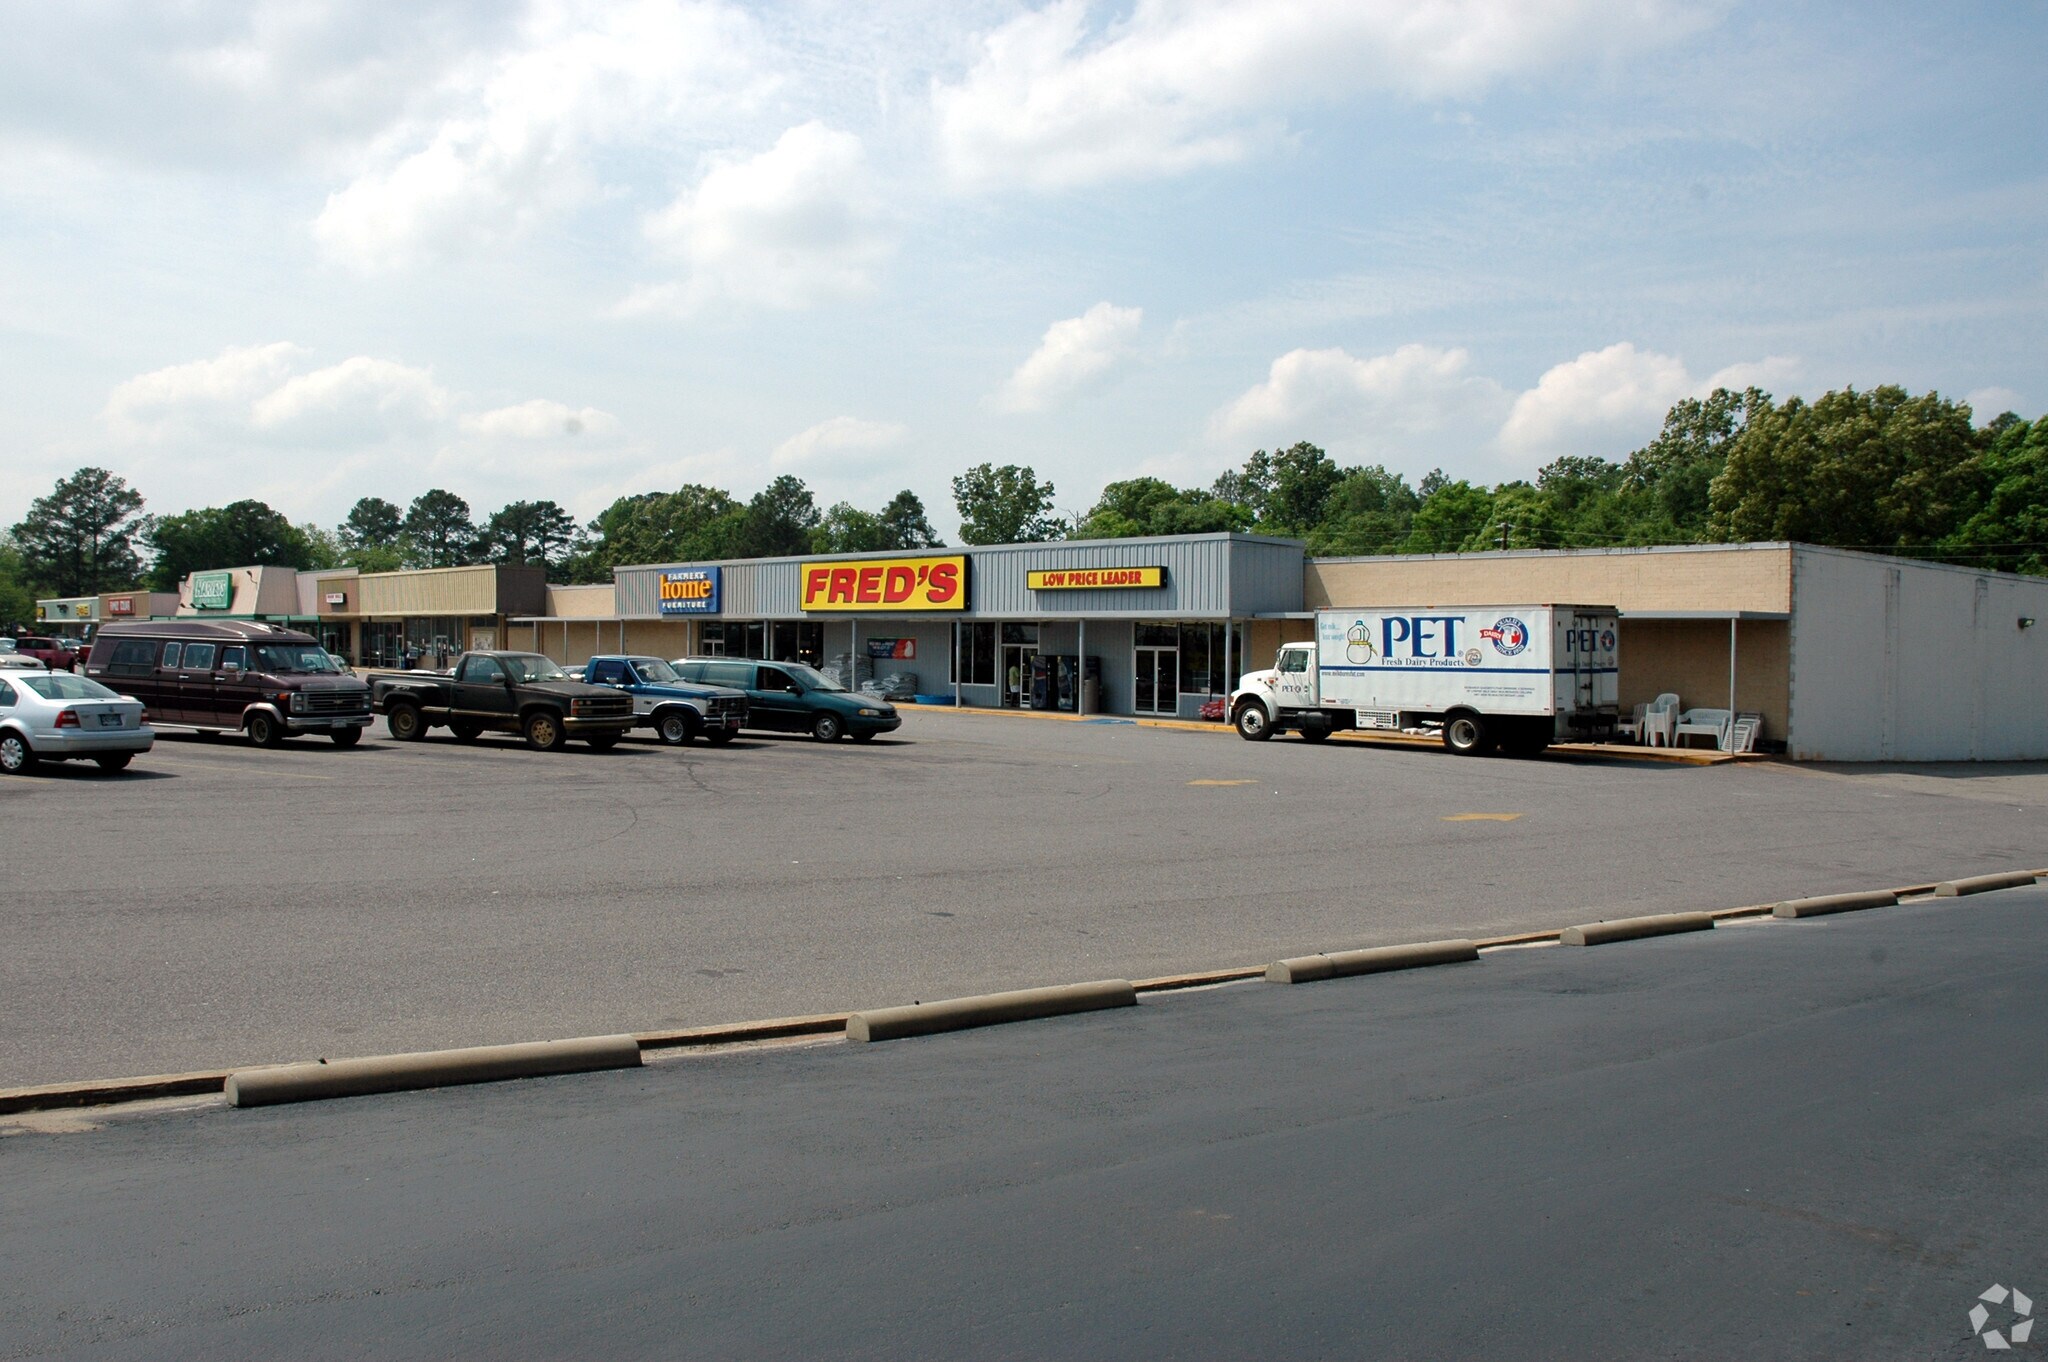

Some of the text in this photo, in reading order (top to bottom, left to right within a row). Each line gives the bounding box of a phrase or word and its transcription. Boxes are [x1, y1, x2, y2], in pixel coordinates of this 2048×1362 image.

[659, 574, 712, 599] home
[805, 563, 959, 604] FRED'S
[1043, 571, 1142, 586] LOW PRICE LEADER
[1381, 616, 1466, 657] PET
[1483, 631, 1502, 639] DAIRY
[1566, 630, 1599, 652] PET
[1382, 658, 1464, 667] Fresh Dairy Products
